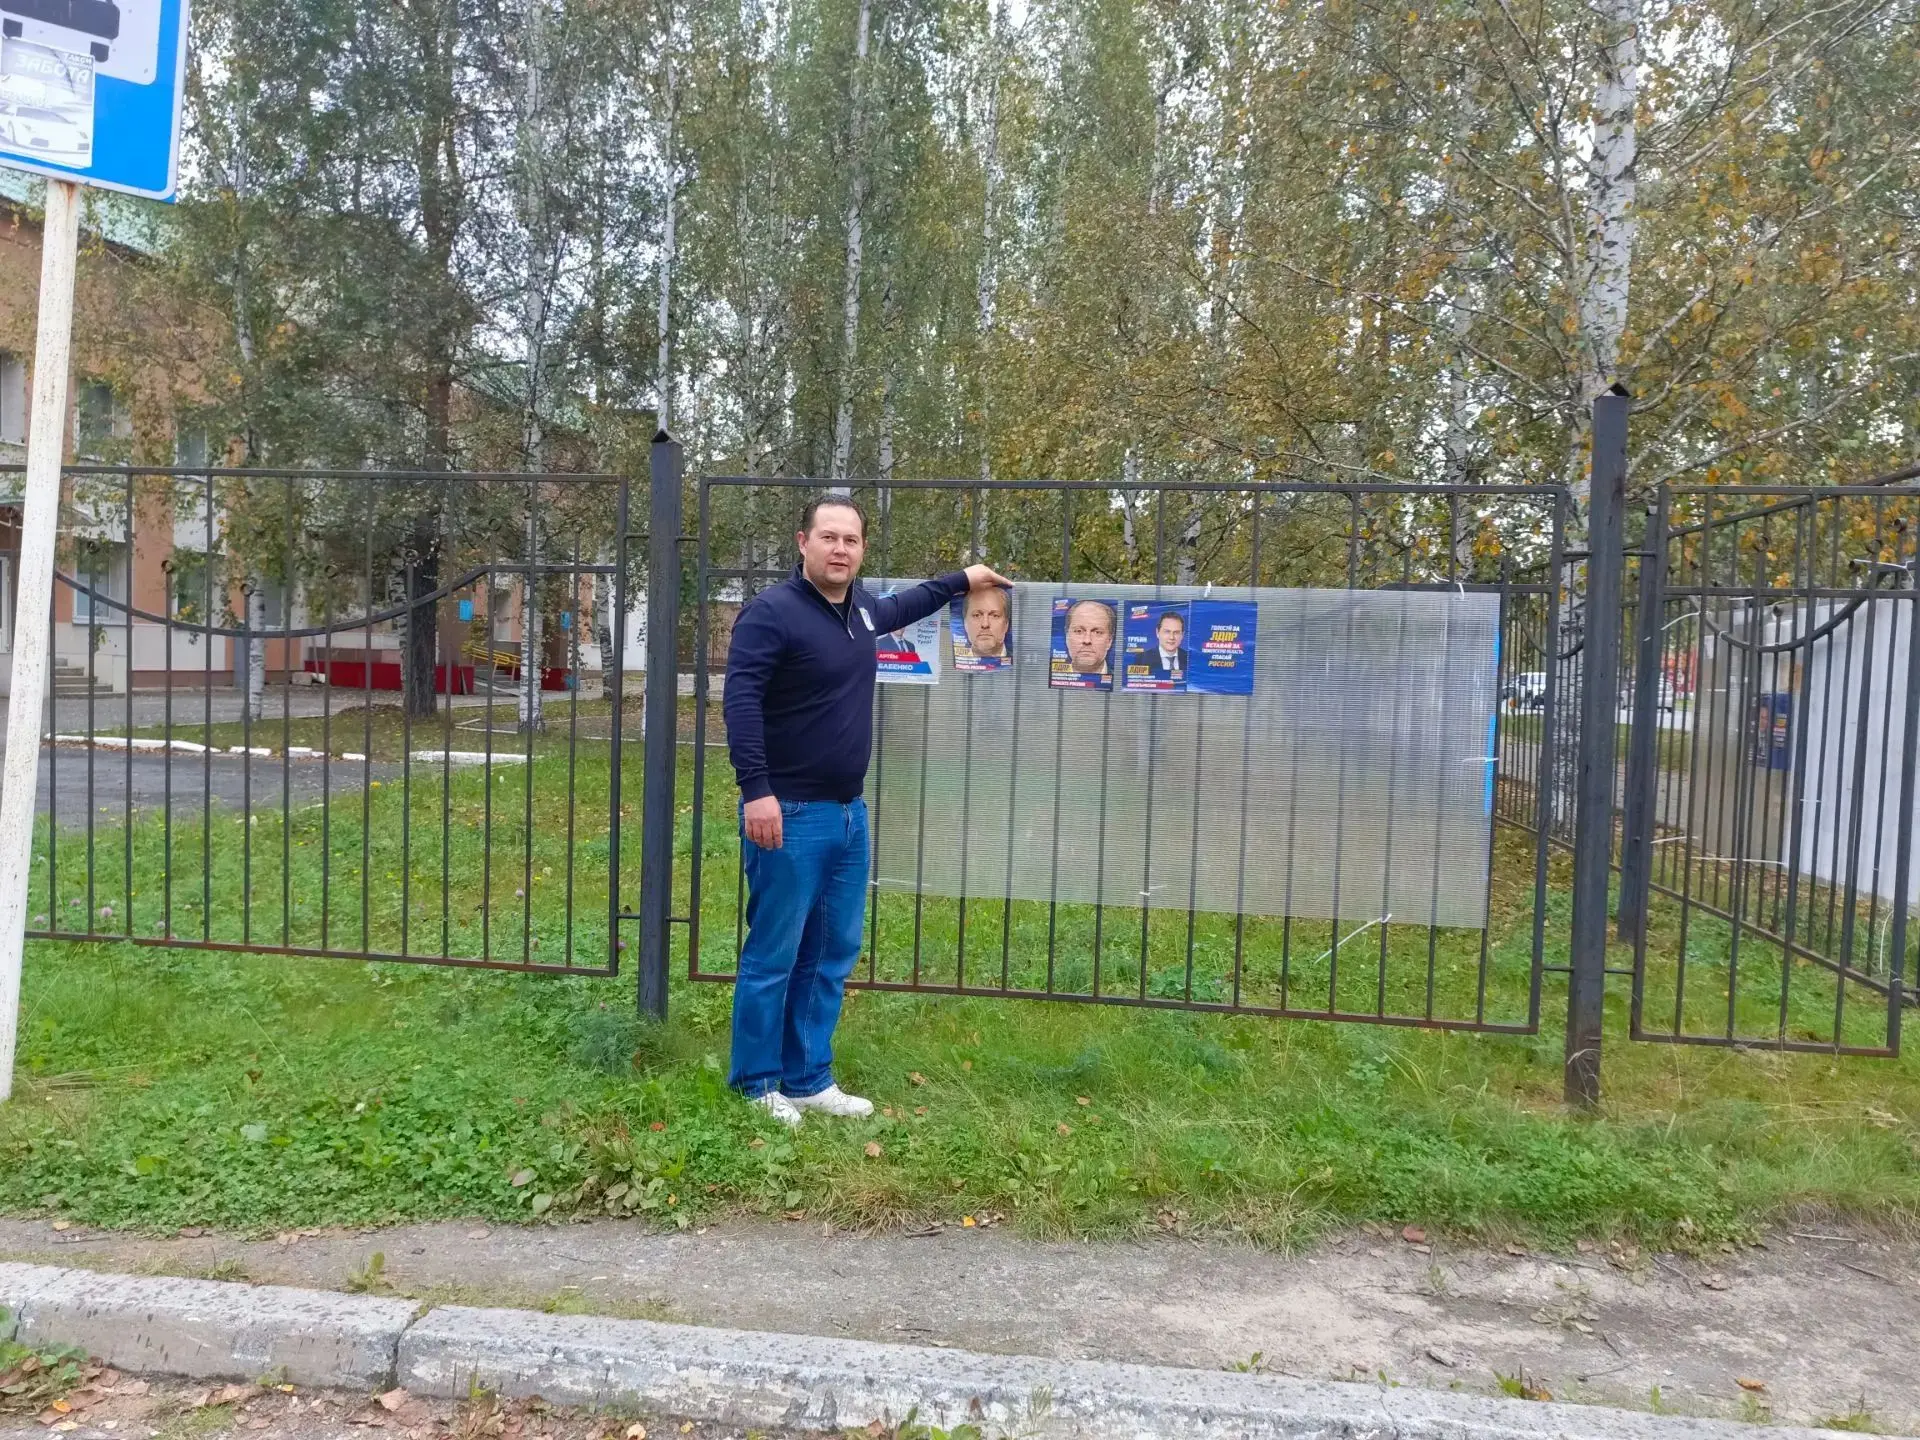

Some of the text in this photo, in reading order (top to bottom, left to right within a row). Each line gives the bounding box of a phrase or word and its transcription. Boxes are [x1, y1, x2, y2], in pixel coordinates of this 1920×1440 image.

[15, 54, 90, 84] ЗАБОТА
[1210, 631, 1238, 642] ЛДПР
[878, 663, 914, 671] БАБЕНКО
[1208, 660, 1235, 668] РОССИЮ
[1128, 665, 1148, 674] ЛДПР
